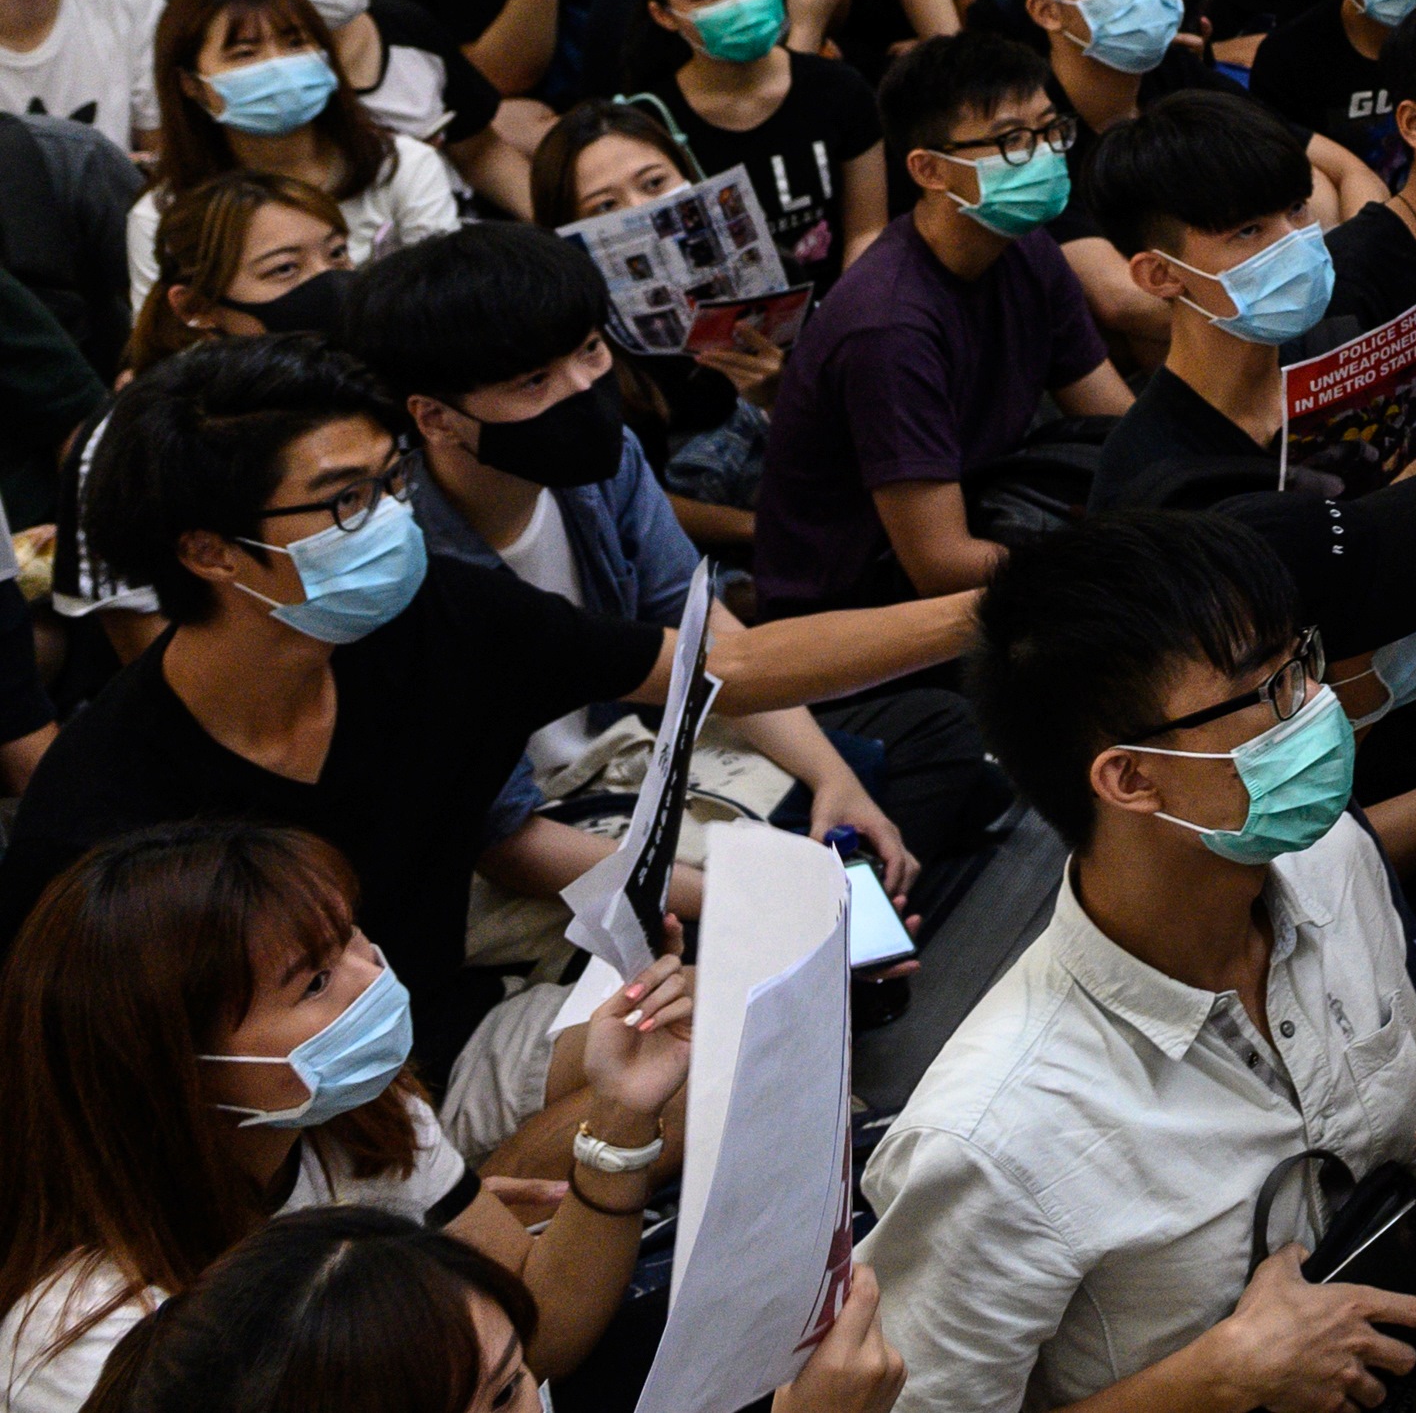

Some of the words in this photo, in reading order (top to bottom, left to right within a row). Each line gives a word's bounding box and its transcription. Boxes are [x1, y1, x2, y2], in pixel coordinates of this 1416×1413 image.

[1339, 326, 1396, 365] POLICE
[1294, 396, 1314, 414] IN
[1318, 369, 1377, 406] METRO
